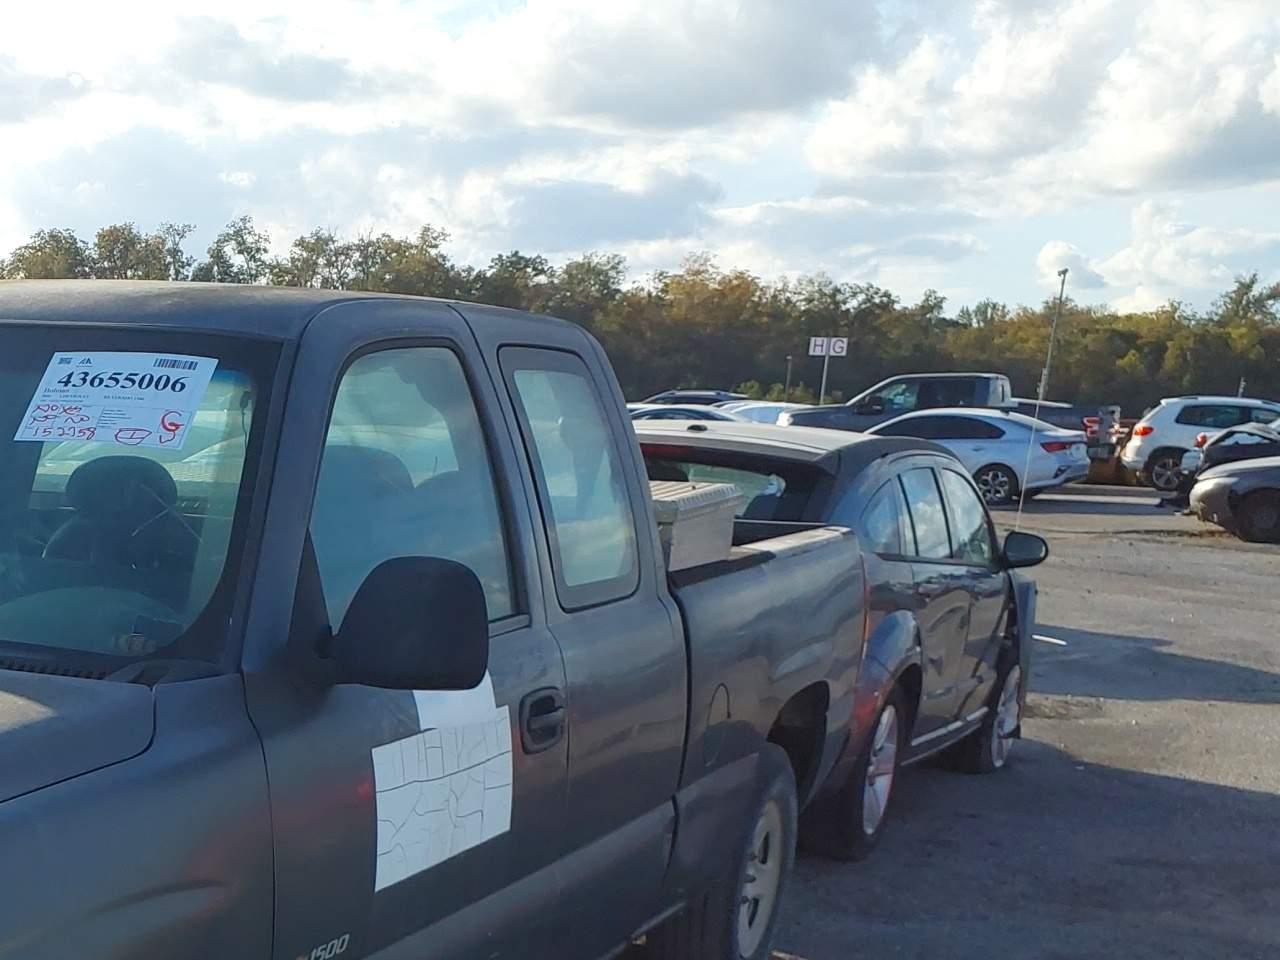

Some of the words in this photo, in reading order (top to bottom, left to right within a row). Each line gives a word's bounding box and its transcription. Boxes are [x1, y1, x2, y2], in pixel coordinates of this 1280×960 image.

[813, 338, 825, 353] H
[832, 338, 845, 354] G
[57, 370, 192, 393] 43655006
